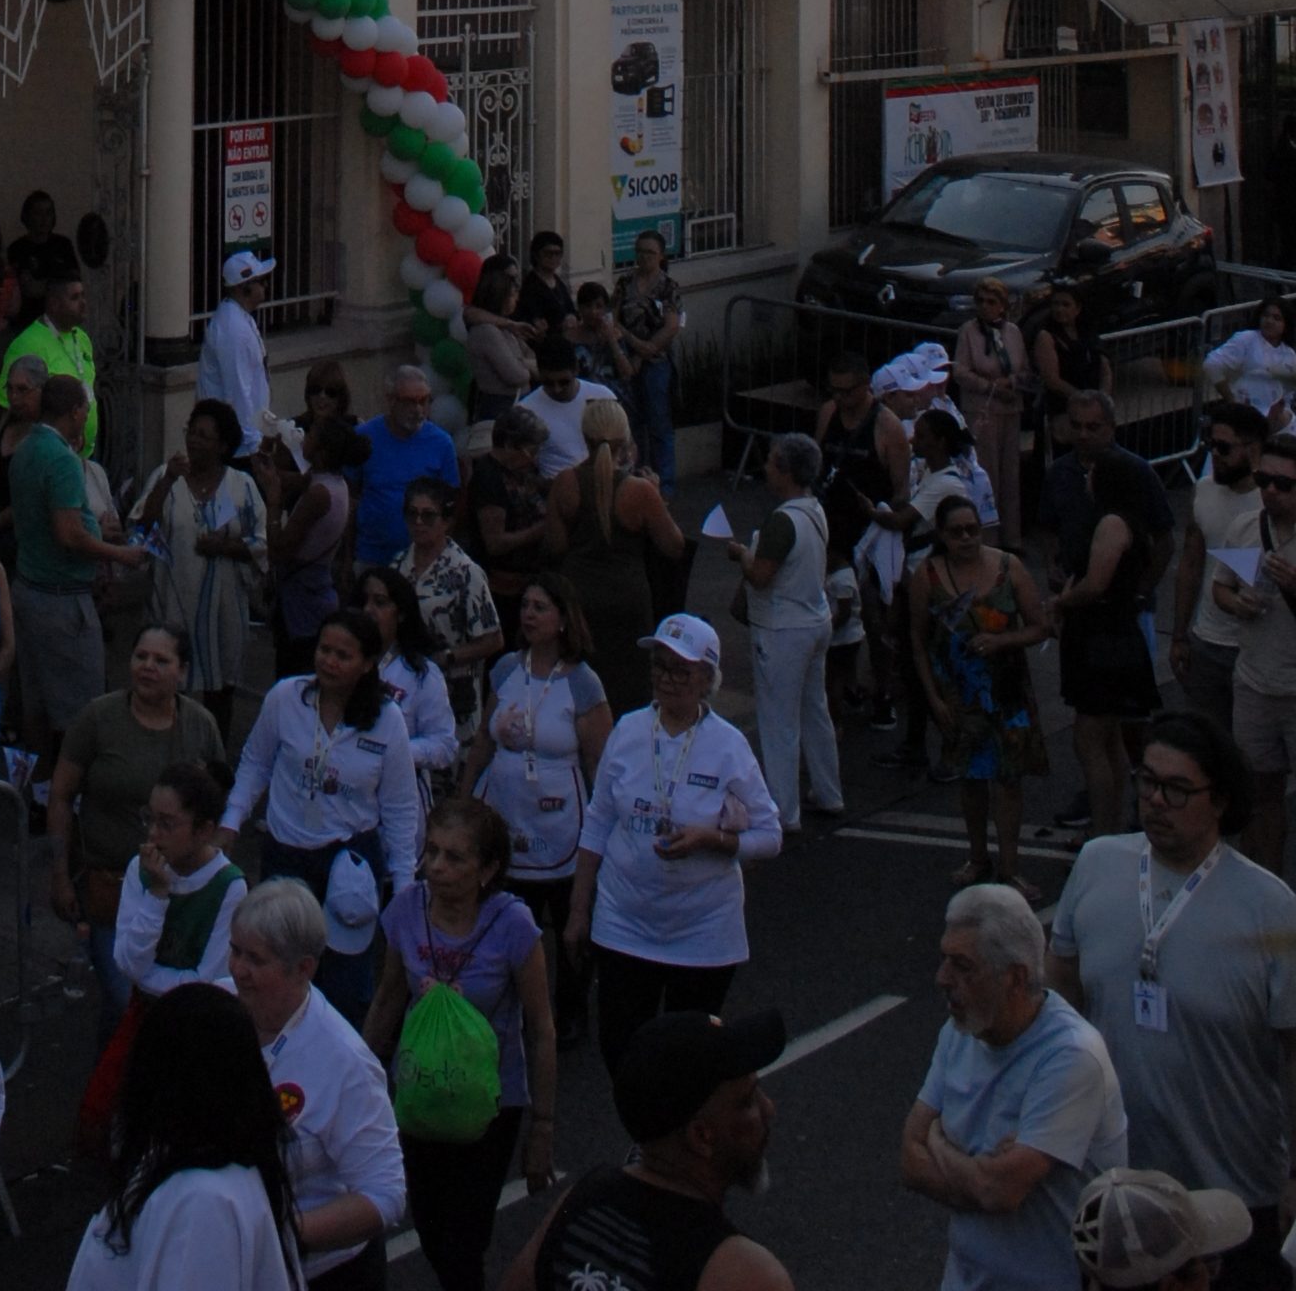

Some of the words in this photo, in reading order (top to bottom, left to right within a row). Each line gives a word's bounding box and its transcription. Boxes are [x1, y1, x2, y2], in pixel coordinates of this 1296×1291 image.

[996, 94, 1003, 107] DE
[230, 130, 244, 143] POR
[245, 127, 266, 142] FAVOR
[243, 145, 269, 160] ENTRAR
[628, 173, 679, 197] SICOOB
